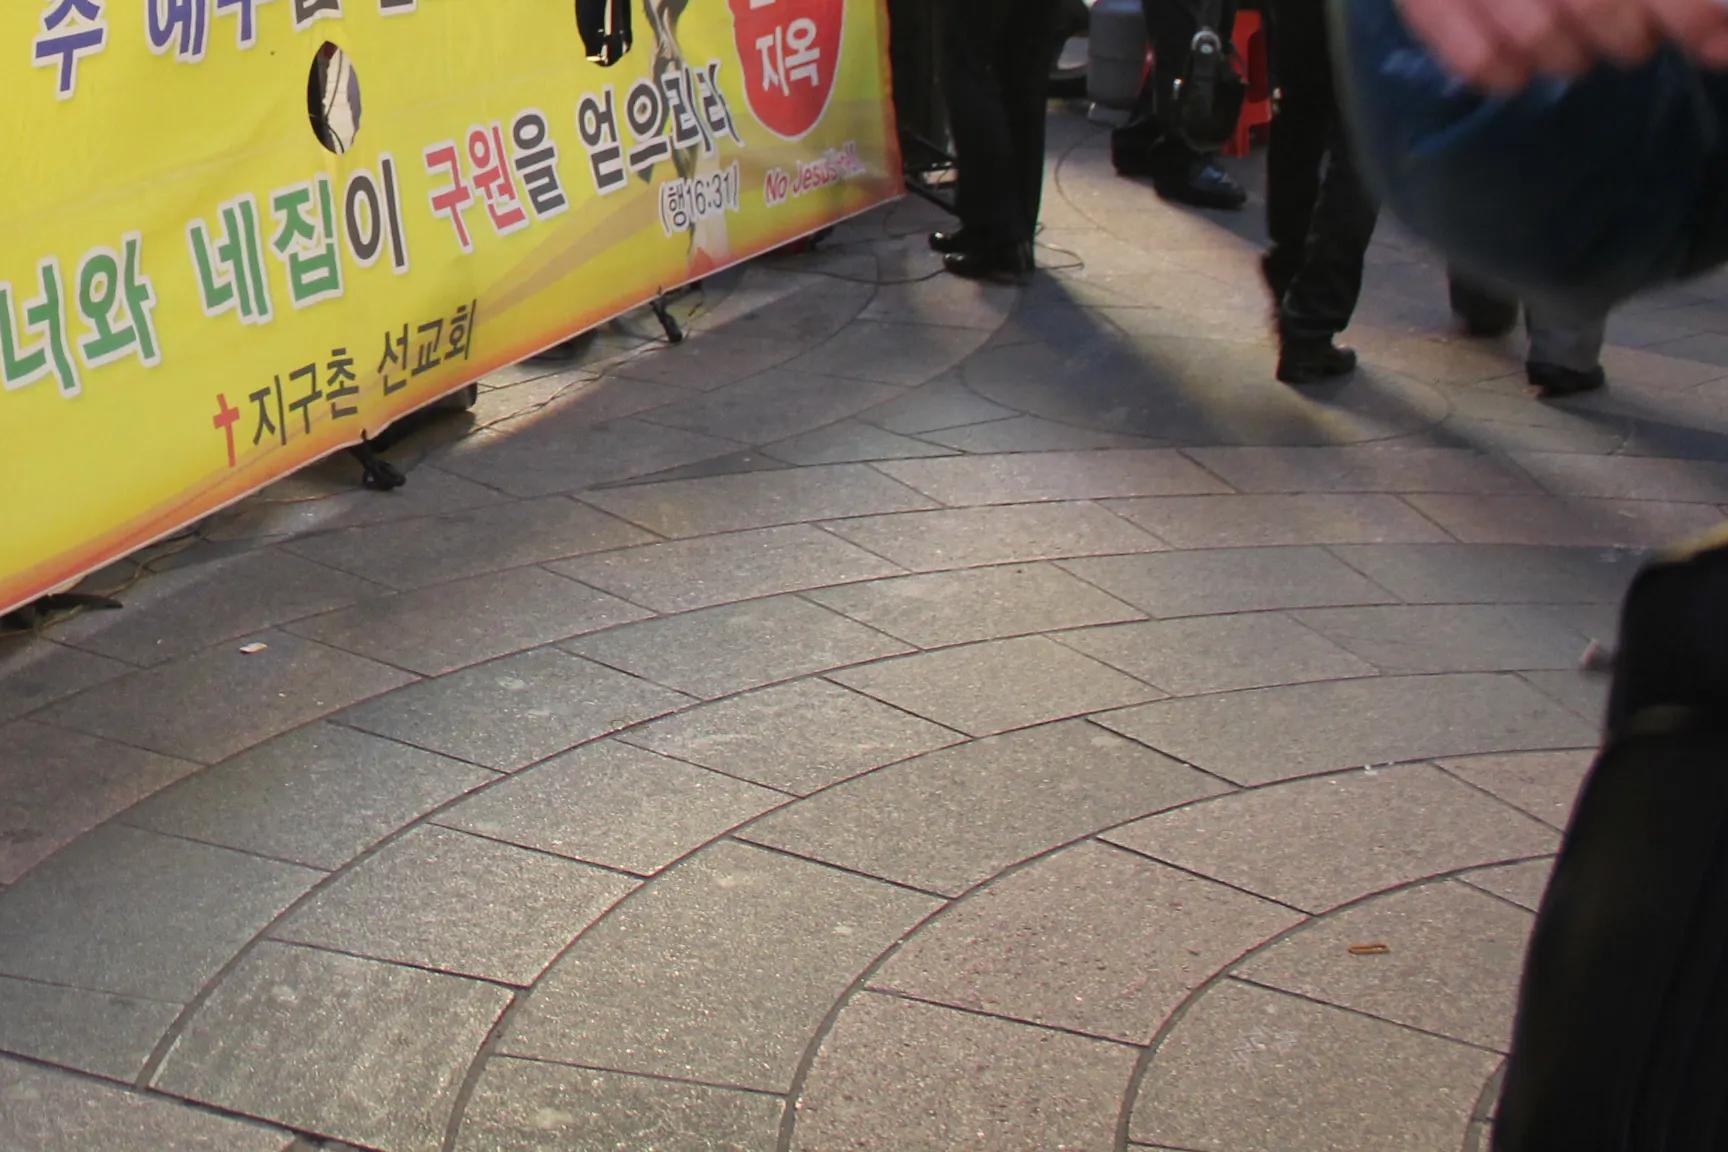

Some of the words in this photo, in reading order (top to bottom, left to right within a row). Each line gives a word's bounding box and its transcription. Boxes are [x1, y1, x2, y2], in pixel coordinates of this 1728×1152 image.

[755, 17, 821, 96] 지옥
[425, 112, 566, 249] 구원을
[578, 62, 740, 189] 얻으리라
[247, 347, 359, 446] 지구촌
[377, 300, 477, 396] 선교회
